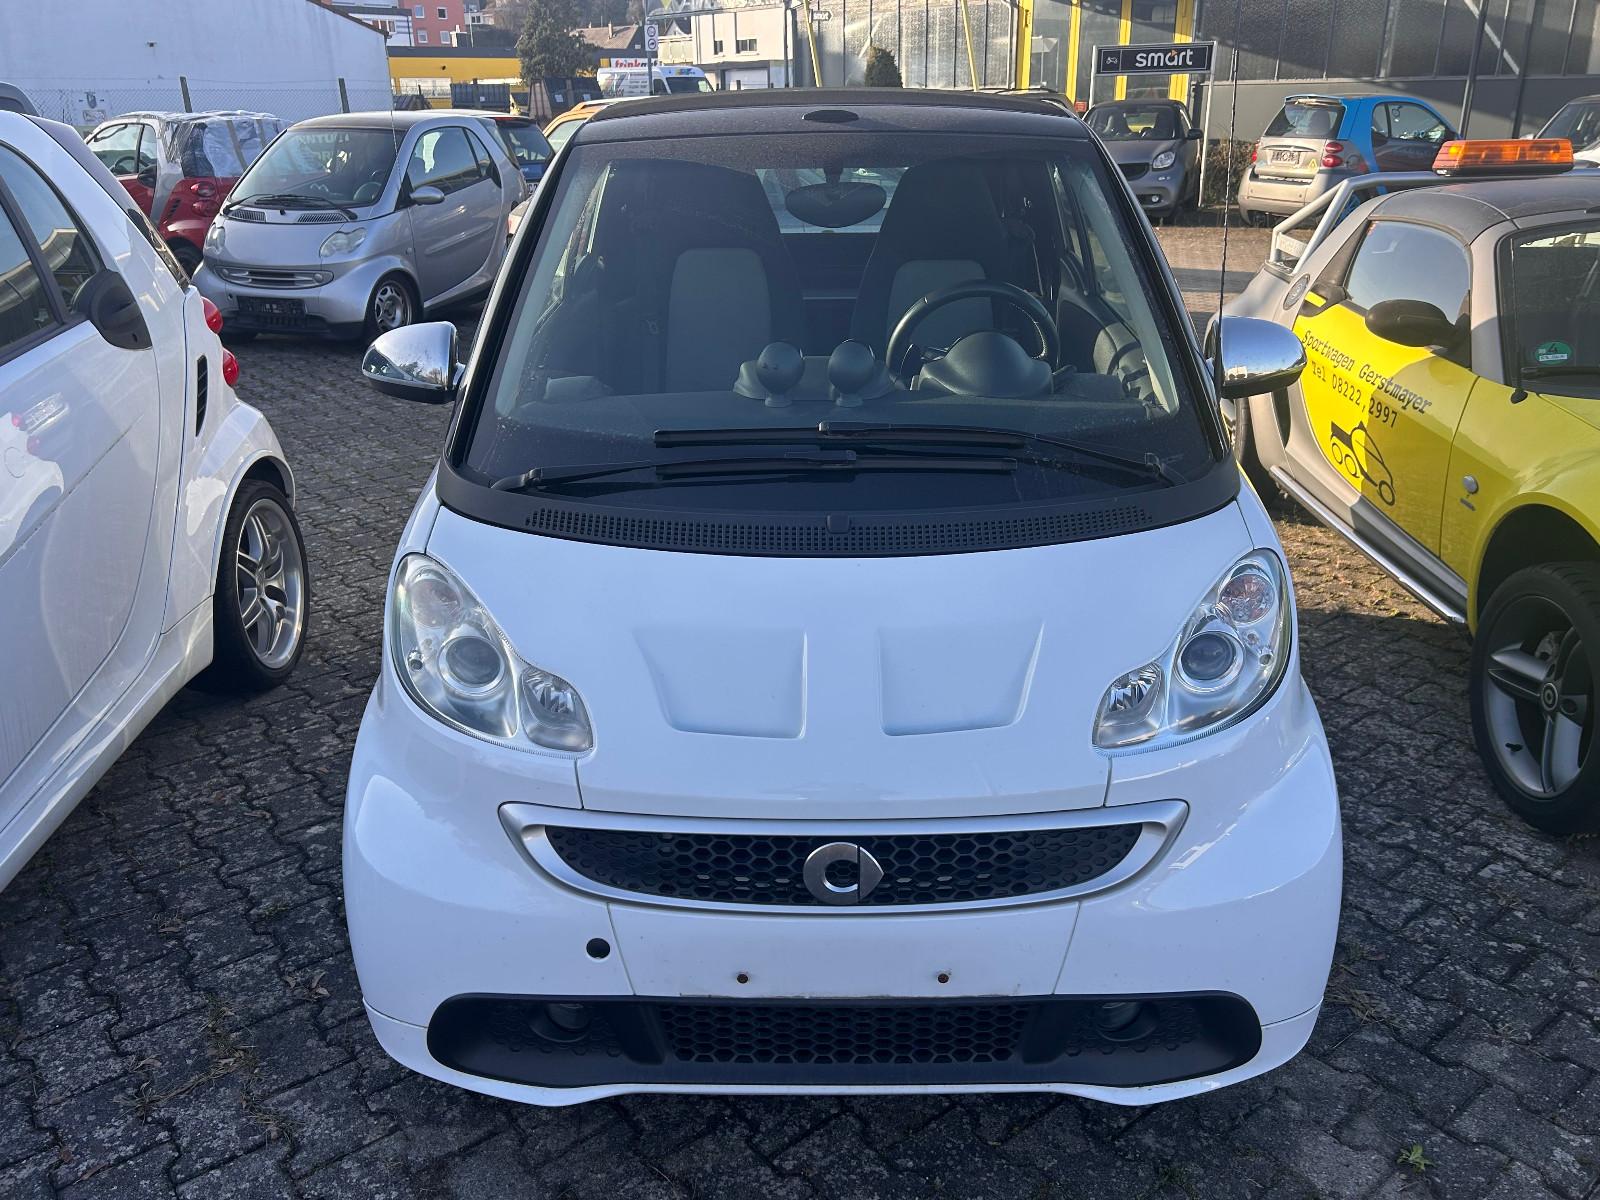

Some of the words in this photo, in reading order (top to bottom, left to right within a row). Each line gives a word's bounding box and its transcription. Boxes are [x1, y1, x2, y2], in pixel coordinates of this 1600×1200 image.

[1135, 48, 1193, 67] smart
[1302, 330, 1355, 372] Sportwagen
[1359, 364, 1432, 414] Gerstmayer
[1311, 361, 1326, 382] Tel
